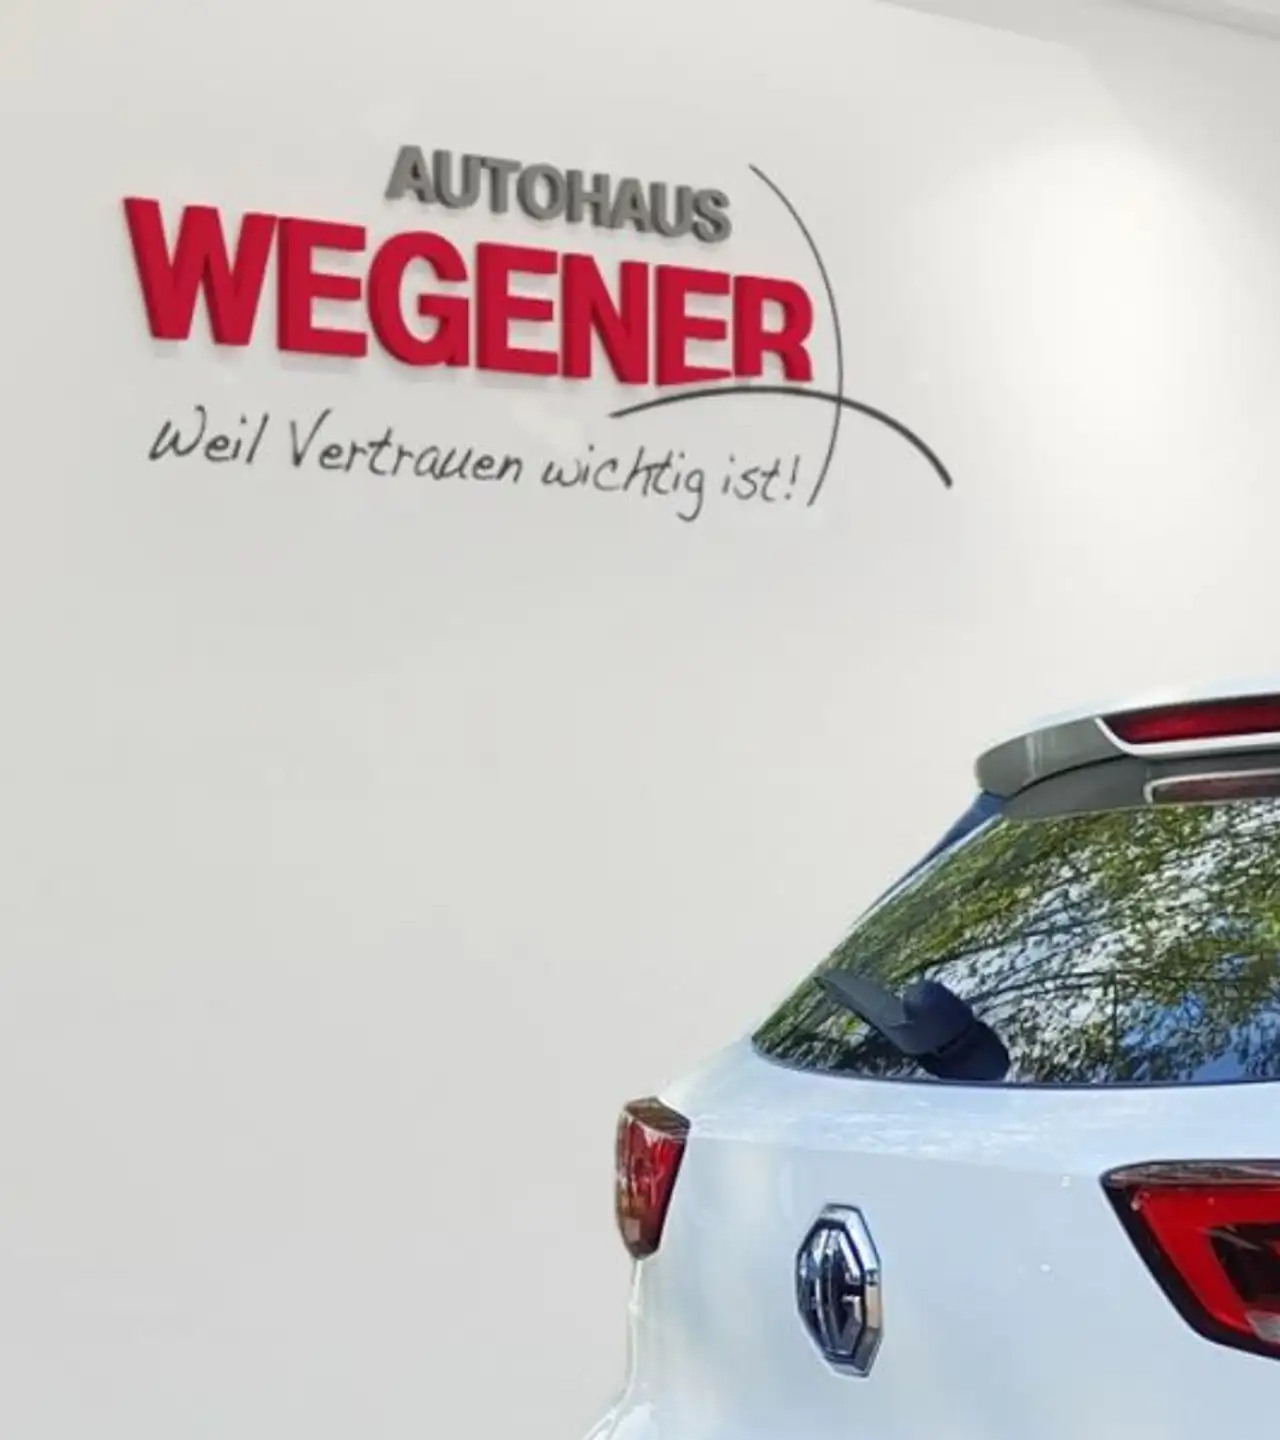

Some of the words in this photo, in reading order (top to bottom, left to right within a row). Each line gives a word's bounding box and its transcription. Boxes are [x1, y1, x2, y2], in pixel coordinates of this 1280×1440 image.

[383, 145, 732, 244] AUTOHAUS
[124, 196, 815, 387] WEGENER
[148, 404, 276, 465] Weil
[289, 408, 524, 485] Vertrauen
[540, 440, 706, 523] wichtig
[721, 454, 801, 507] ist!
